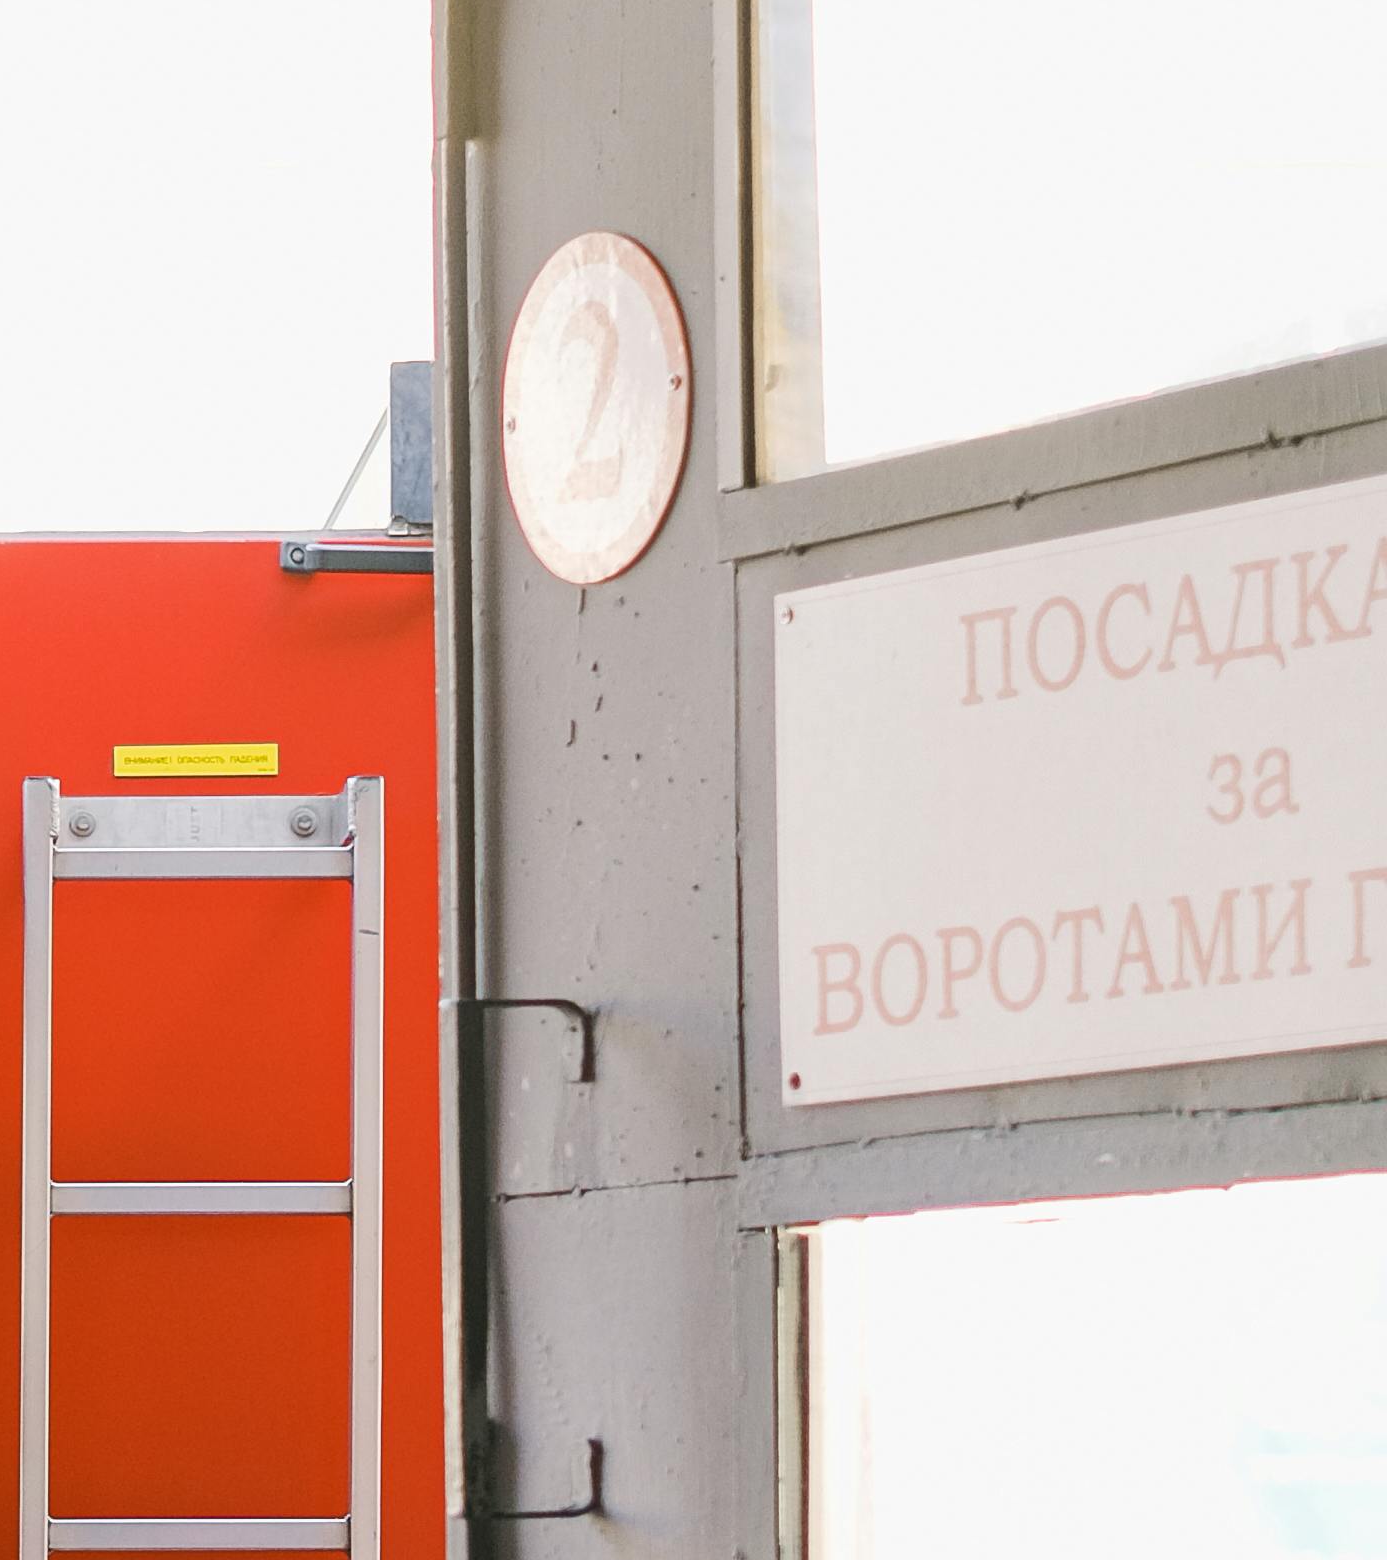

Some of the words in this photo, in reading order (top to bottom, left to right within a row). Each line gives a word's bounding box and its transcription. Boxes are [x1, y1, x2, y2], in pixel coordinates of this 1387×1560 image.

[557, 299, 624, 504] 2
[123, 755, 173, 766] ВНИМАНИЕ!
[176, 755, 226, 765] ОПАСНОСТЬ
[229, 754, 269, 764] ПАДЕНИЯ
[1206, 746, 1300, 824] за
[810, 877, 1313, 1037] ВОРОТАМИ
